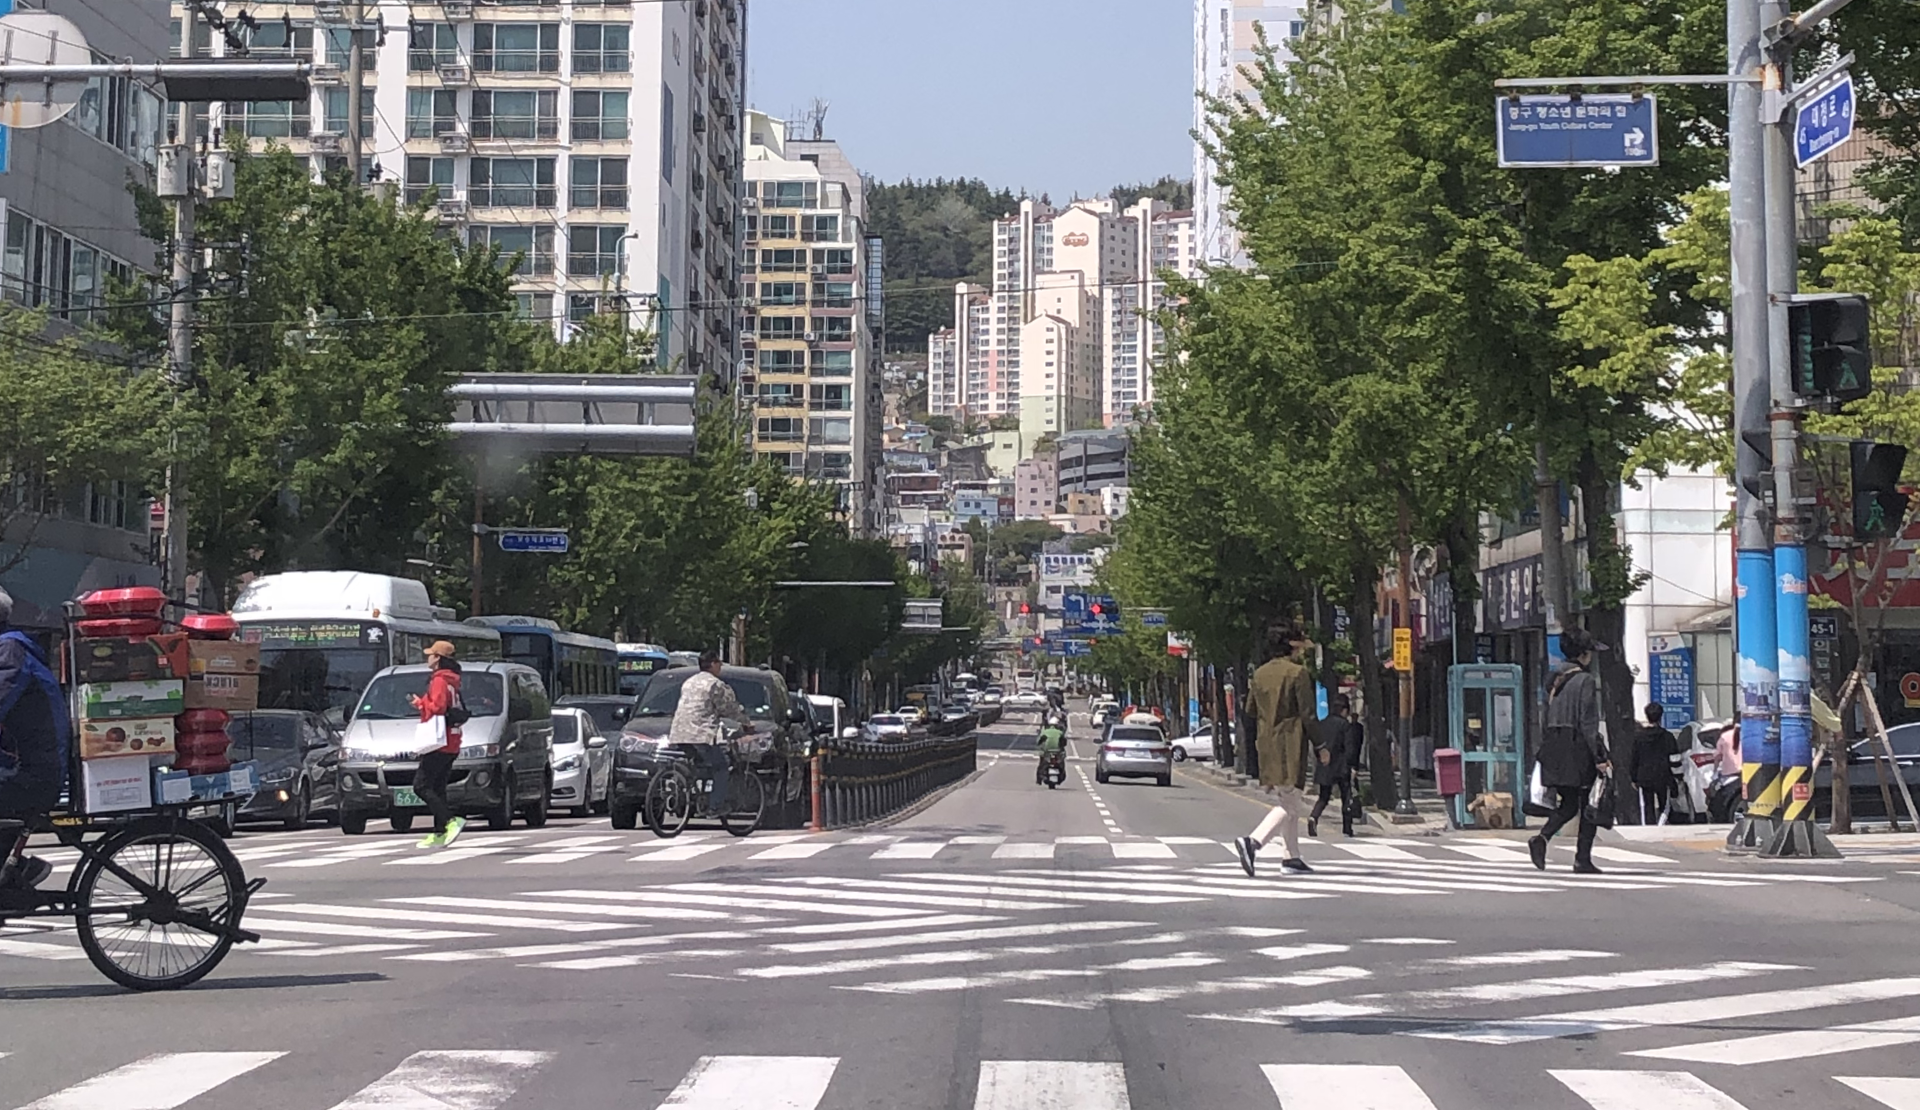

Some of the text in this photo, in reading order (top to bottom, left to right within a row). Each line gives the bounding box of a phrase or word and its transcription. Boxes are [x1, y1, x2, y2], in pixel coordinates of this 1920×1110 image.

[1509, 106, 1532, 119] 중구
[1536, 106, 1572, 119] 청소년
[1575, 106, 1612, 118] 문화의
[1811, 94, 1837, 128] 대청로
[1810, 624, 1834, 634] 45-1
